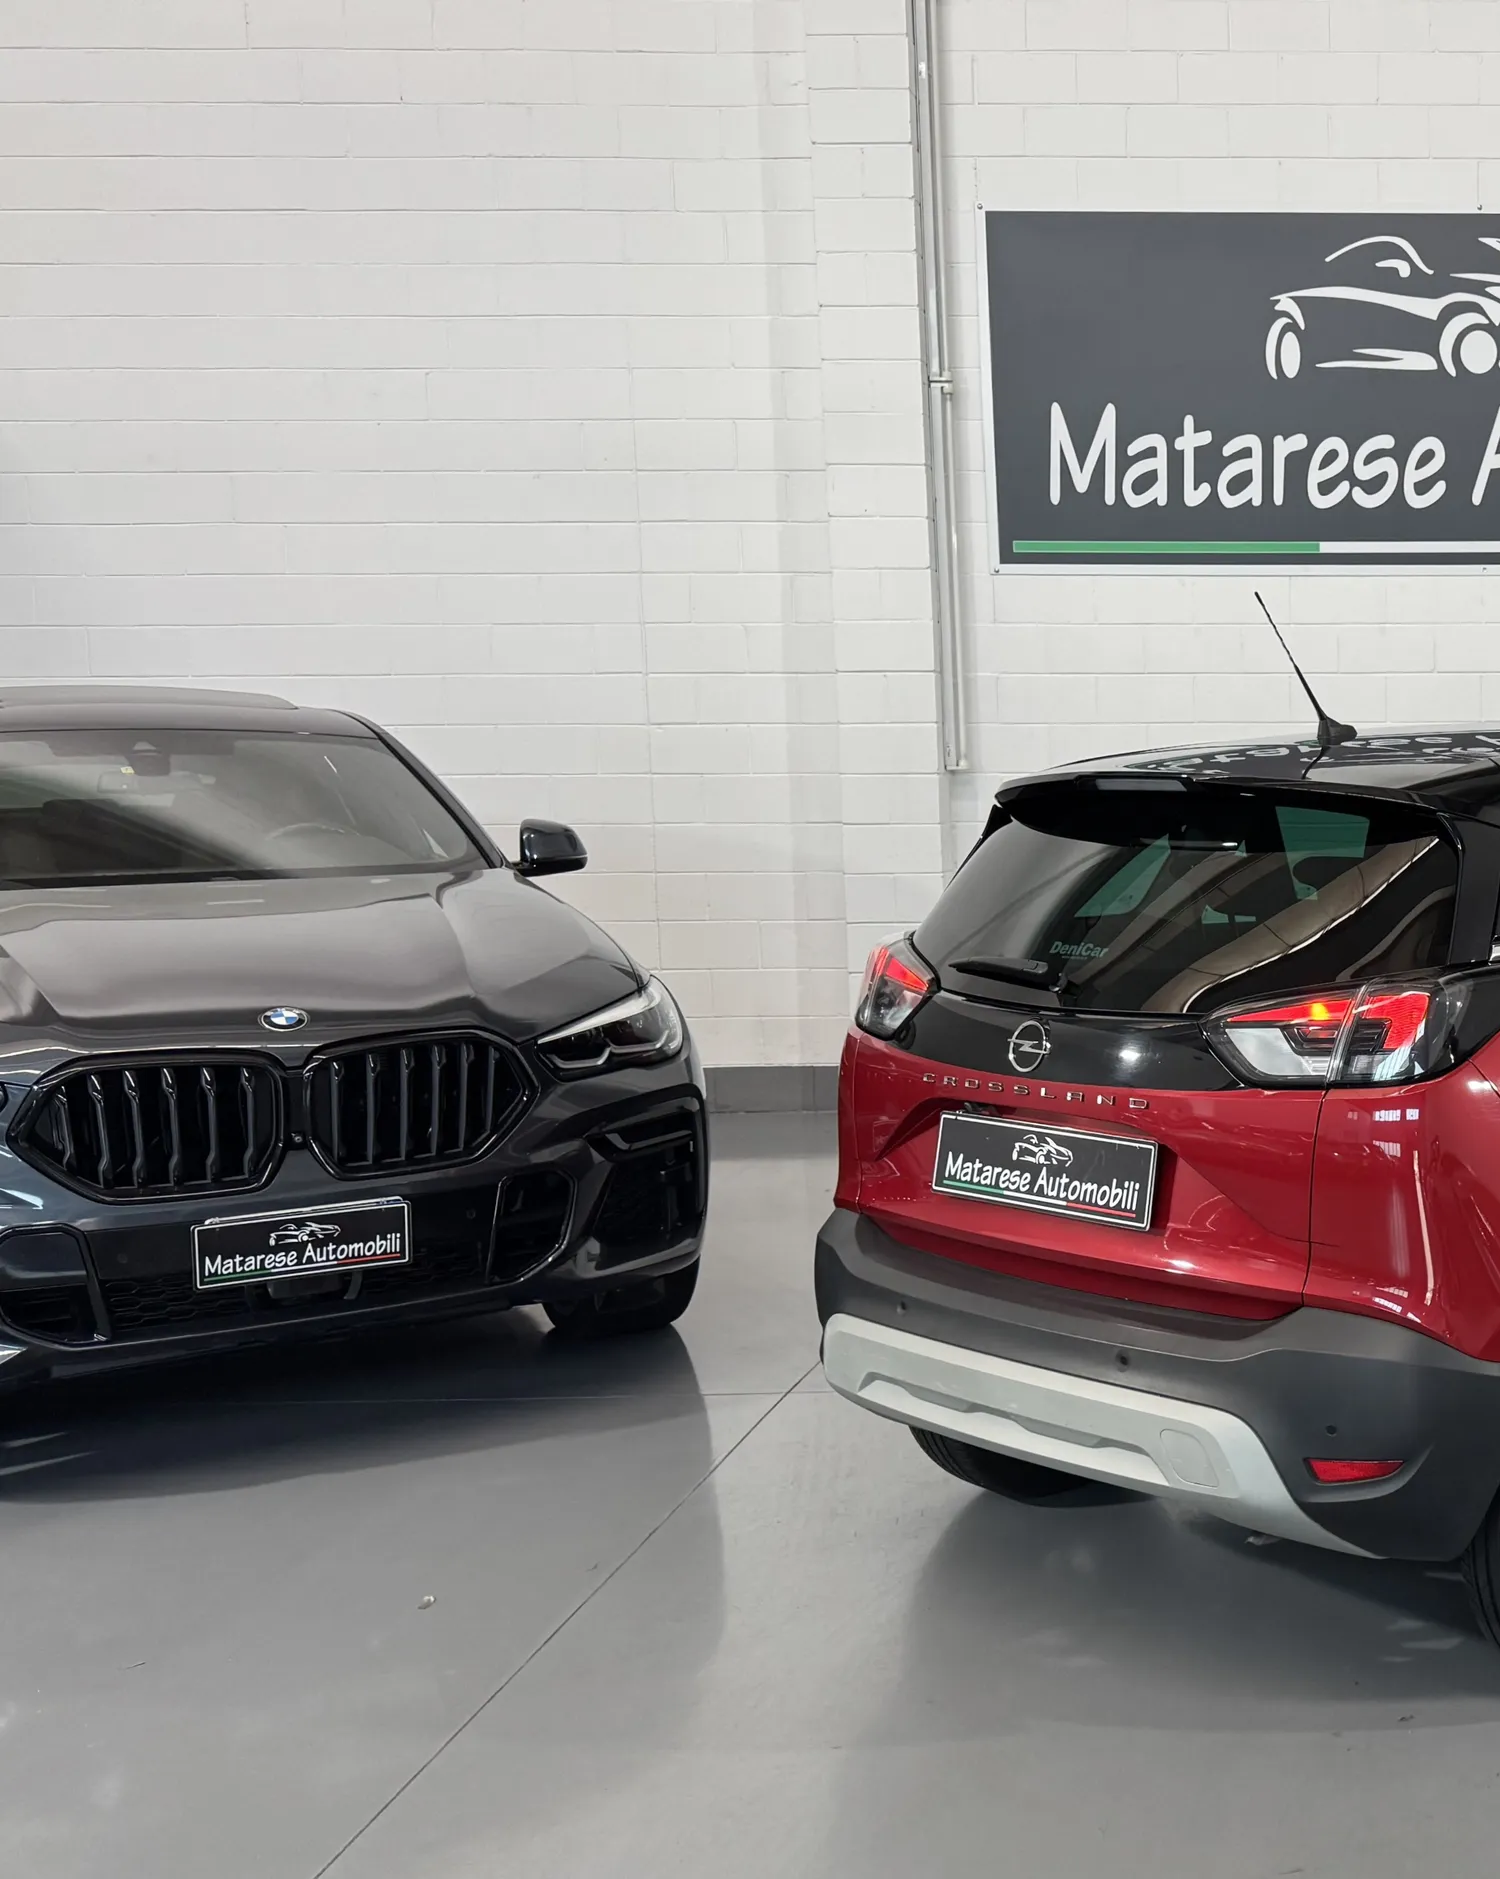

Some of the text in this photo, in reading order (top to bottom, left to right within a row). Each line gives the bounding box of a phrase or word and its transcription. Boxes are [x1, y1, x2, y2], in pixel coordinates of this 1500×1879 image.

[1049, 401, 1447, 509] Matarese
[1049, 941, 1109, 957] DeniCar
[923, 1072, 1148, 1109] CROSSLAND
[944, 1150, 1140, 1211] Matarese Automobili
[204, 1232, 401, 1277] Matarese Automobili
